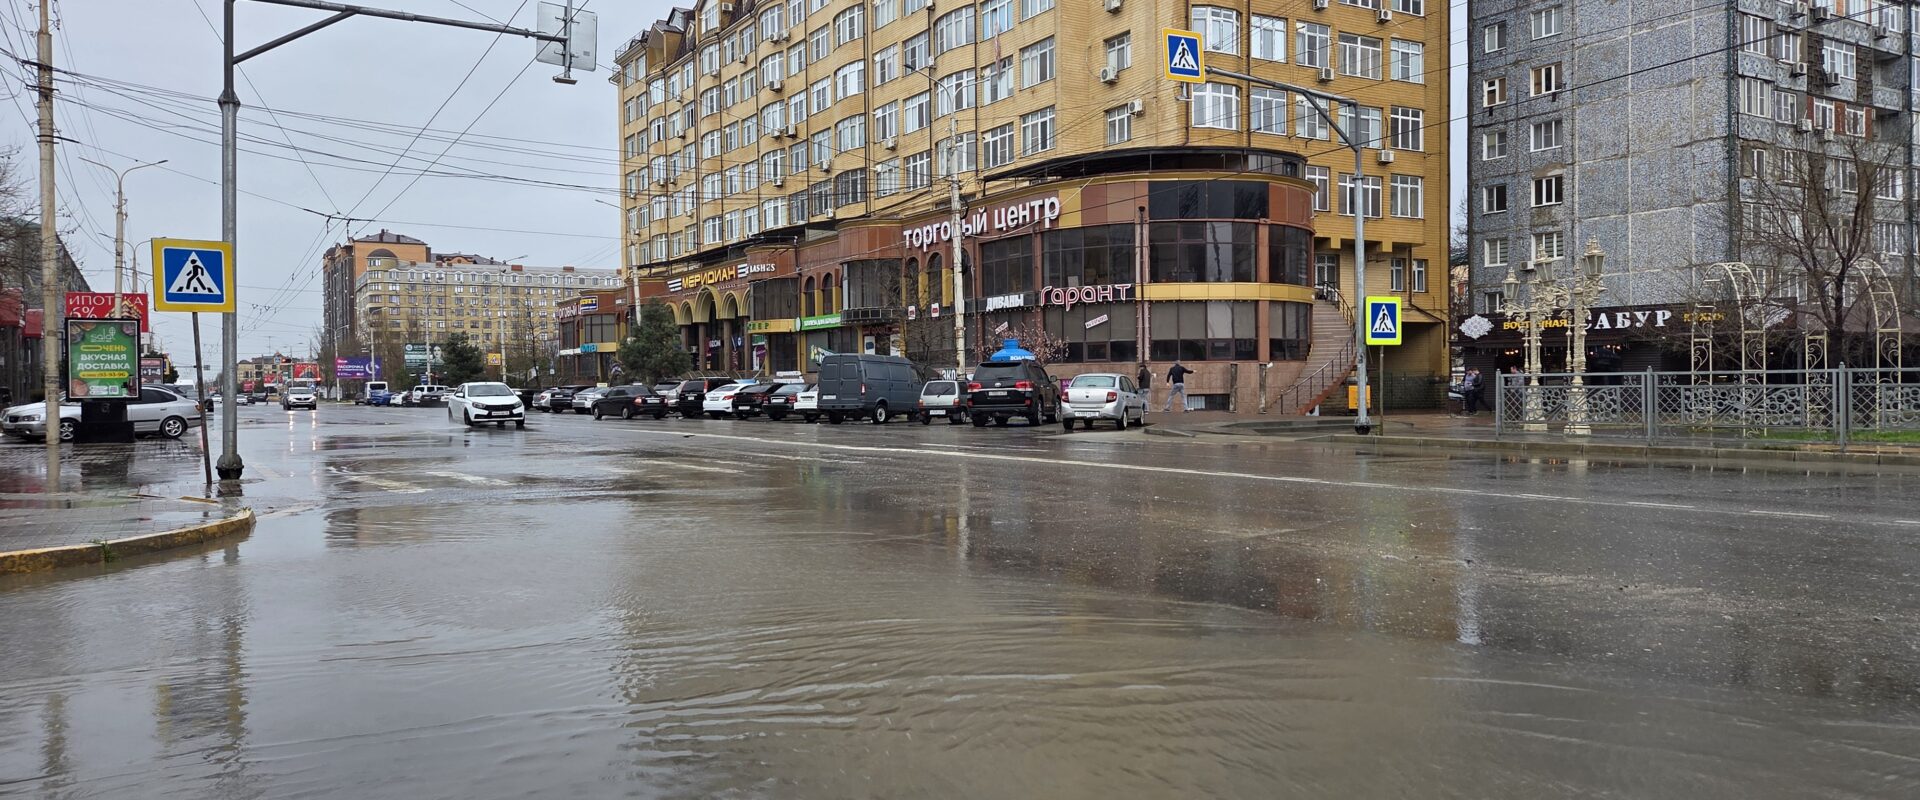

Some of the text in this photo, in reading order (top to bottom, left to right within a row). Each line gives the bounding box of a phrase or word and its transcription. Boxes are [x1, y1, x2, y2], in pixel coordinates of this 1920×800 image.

[903, 207, 988, 252] торгоый
[682, 266, 736, 289] МЕРИДИАН
[69, 295, 144, 306] ИПОТКА
[986, 294, 1024, 312] ДИВАНЫ
[1503, 319, 1568, 330] ВОСТЧНАЯ
[80, 353, 127, 361] ВКУСНАЯ
[77, 362, 130, 371] ДОСТАВКА
